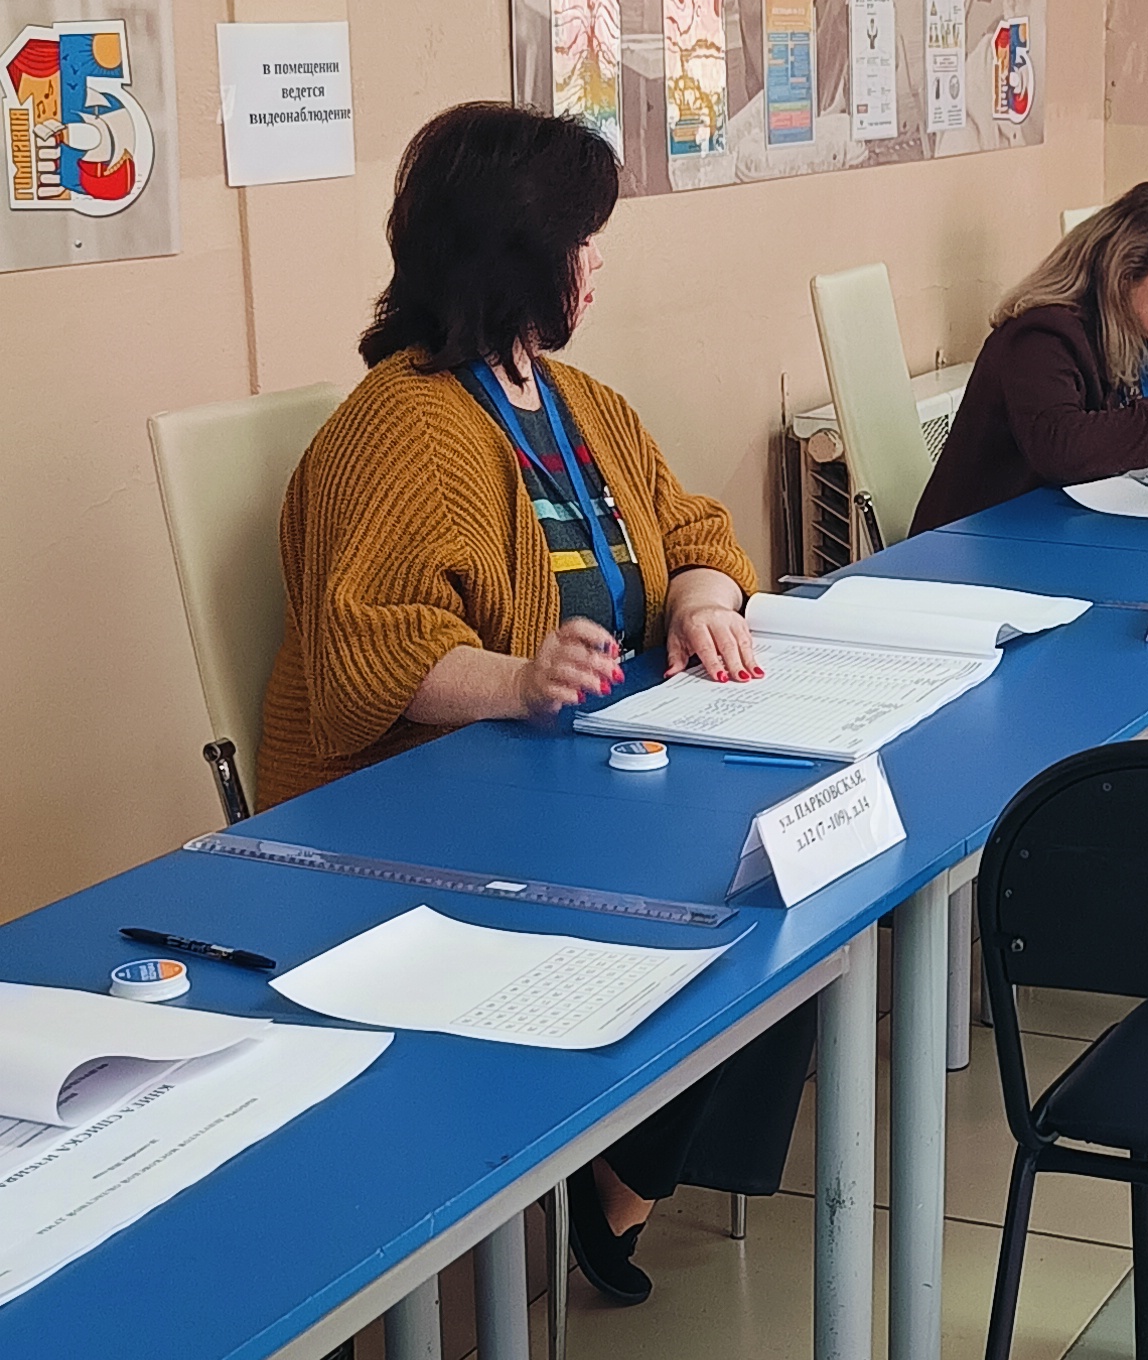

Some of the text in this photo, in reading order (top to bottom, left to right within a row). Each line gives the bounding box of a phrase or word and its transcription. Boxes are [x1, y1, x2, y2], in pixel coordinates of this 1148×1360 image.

[274, 61, 340, 77] помещении
[281, 85, 325, 101] ведется
[249, 106, 351, 127] видеонаблюдение
